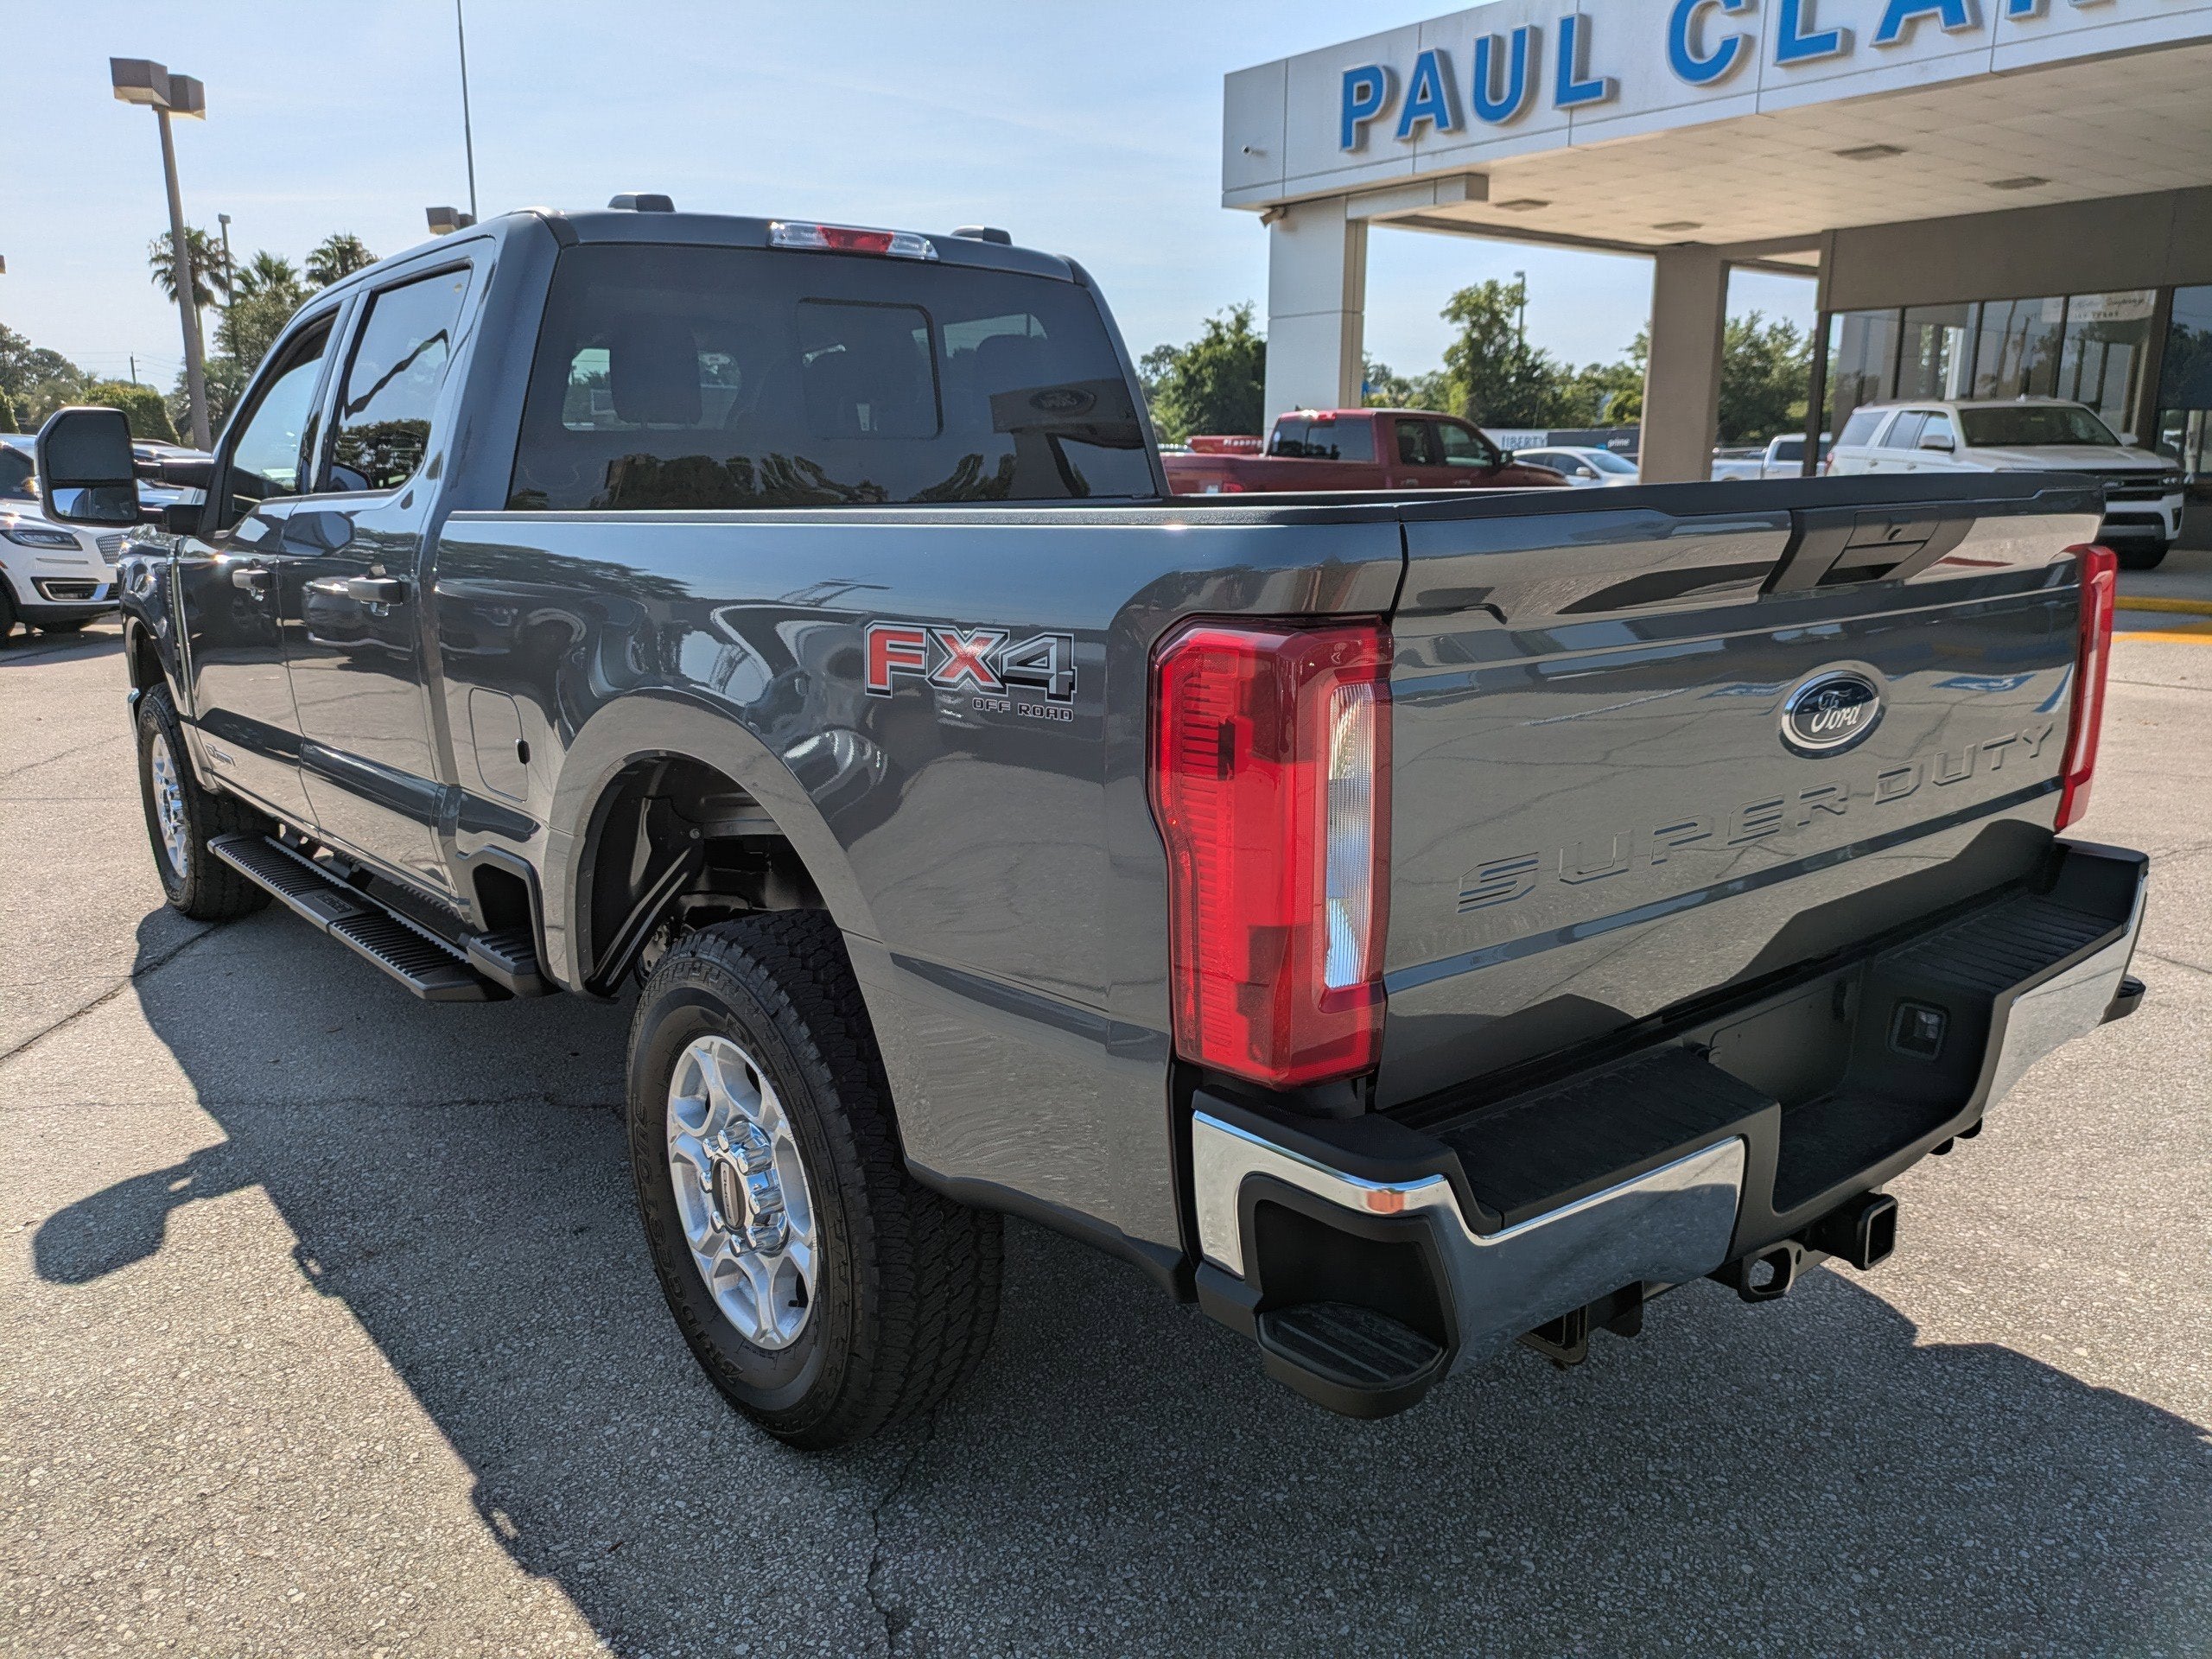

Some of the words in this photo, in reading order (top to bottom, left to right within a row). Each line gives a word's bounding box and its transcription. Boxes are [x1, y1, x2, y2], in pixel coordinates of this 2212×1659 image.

[1340, 13, 1614, 152] PAUL
[864, 620, 1077, 704] FX4
[972, 697, 1011, 714] OFF
[1018, 702, 1074, 722] ROAD
[1810, 689, 1863, 734] Ford
[1457, 779, 1850, 914] SUPER
[1874, 721, 2054, 805] DUTY
